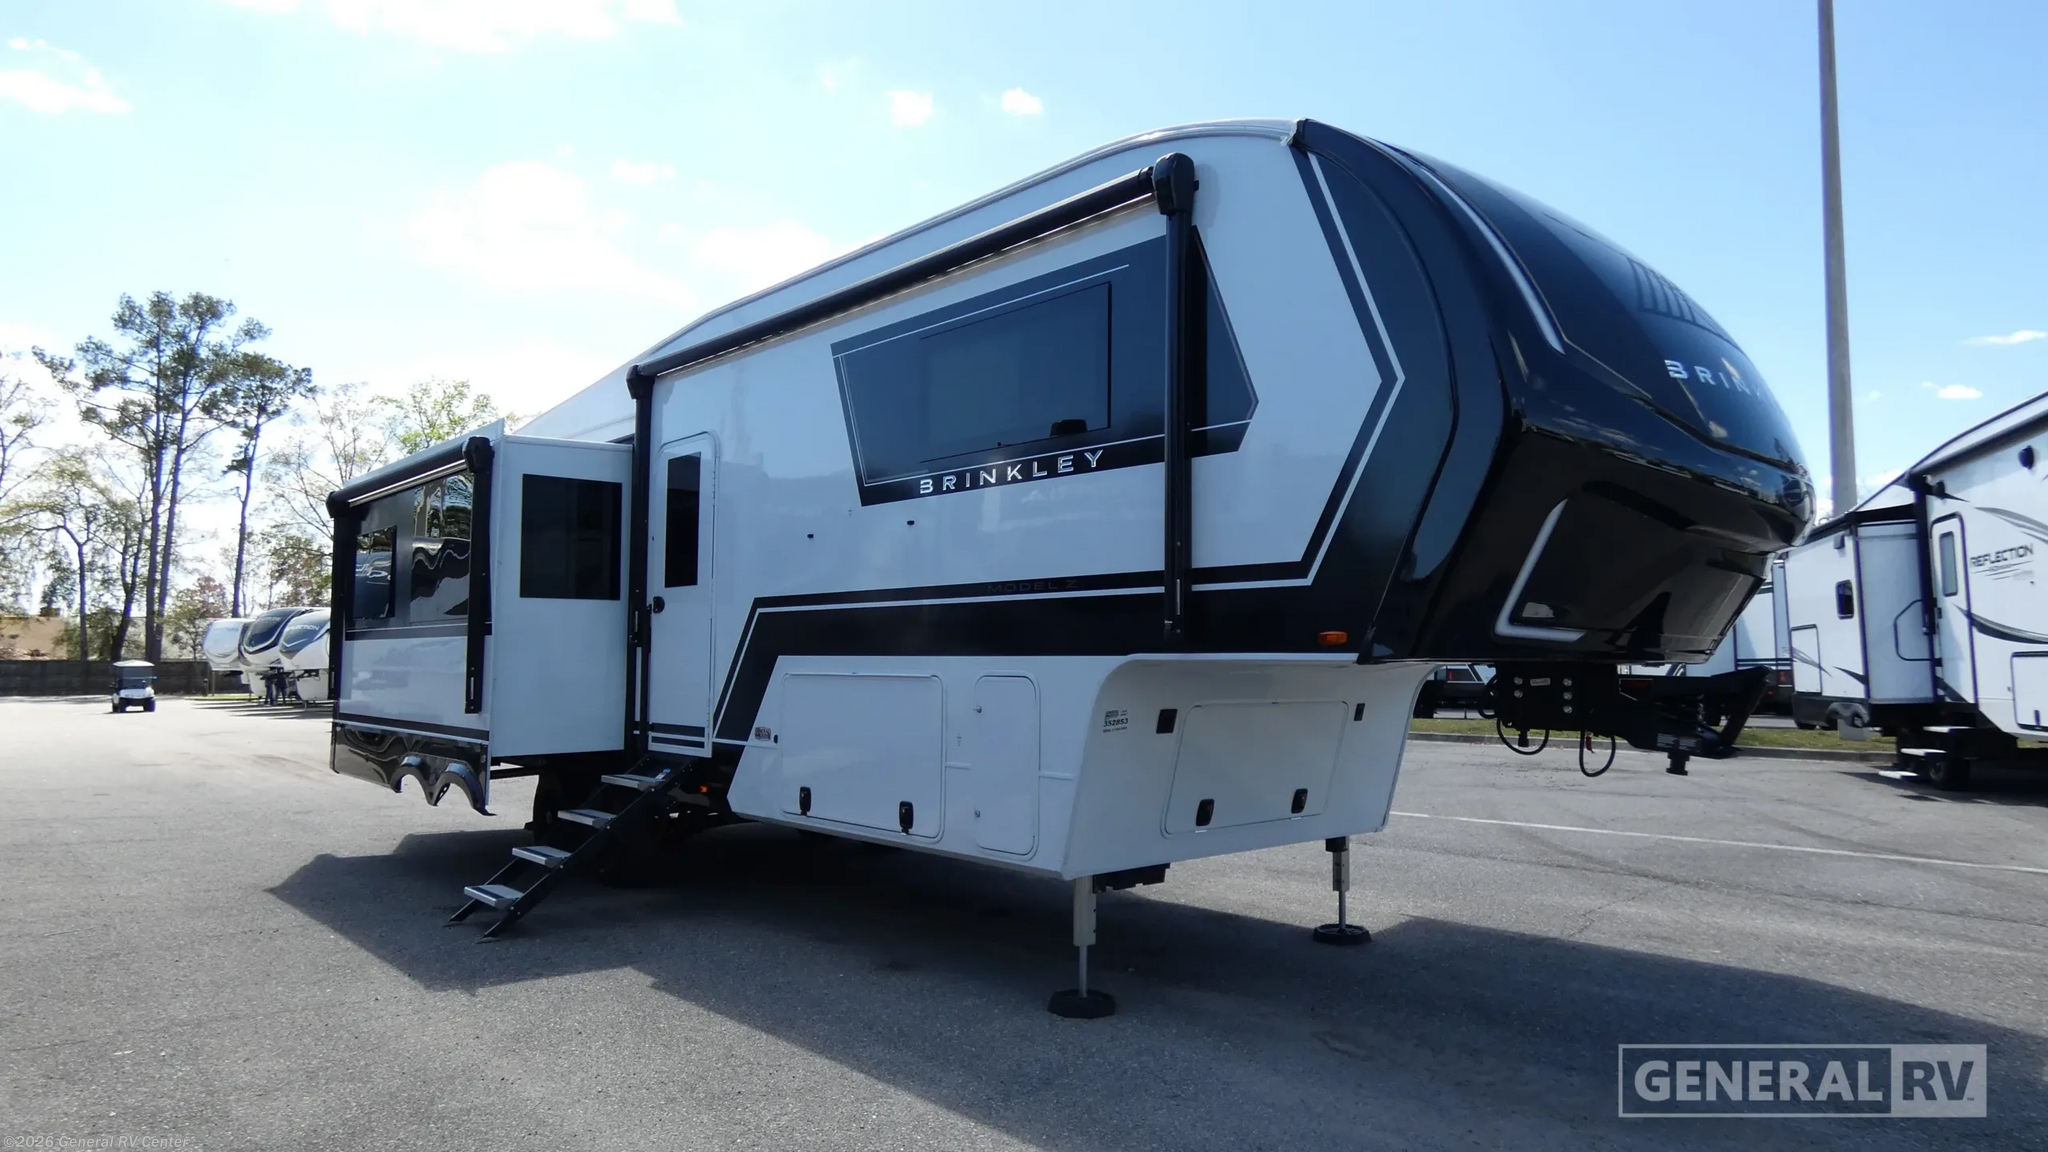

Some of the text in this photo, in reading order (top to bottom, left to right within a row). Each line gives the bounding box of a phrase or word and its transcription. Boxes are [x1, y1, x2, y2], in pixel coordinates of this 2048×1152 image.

[919, 449, 1104, 495] BRINKLEY
[1970, 543, 2034, 568] REFLECTION
[987, 579, 1079, 594] MODEL Z
[1103, 717, 1129, 728] 352853
